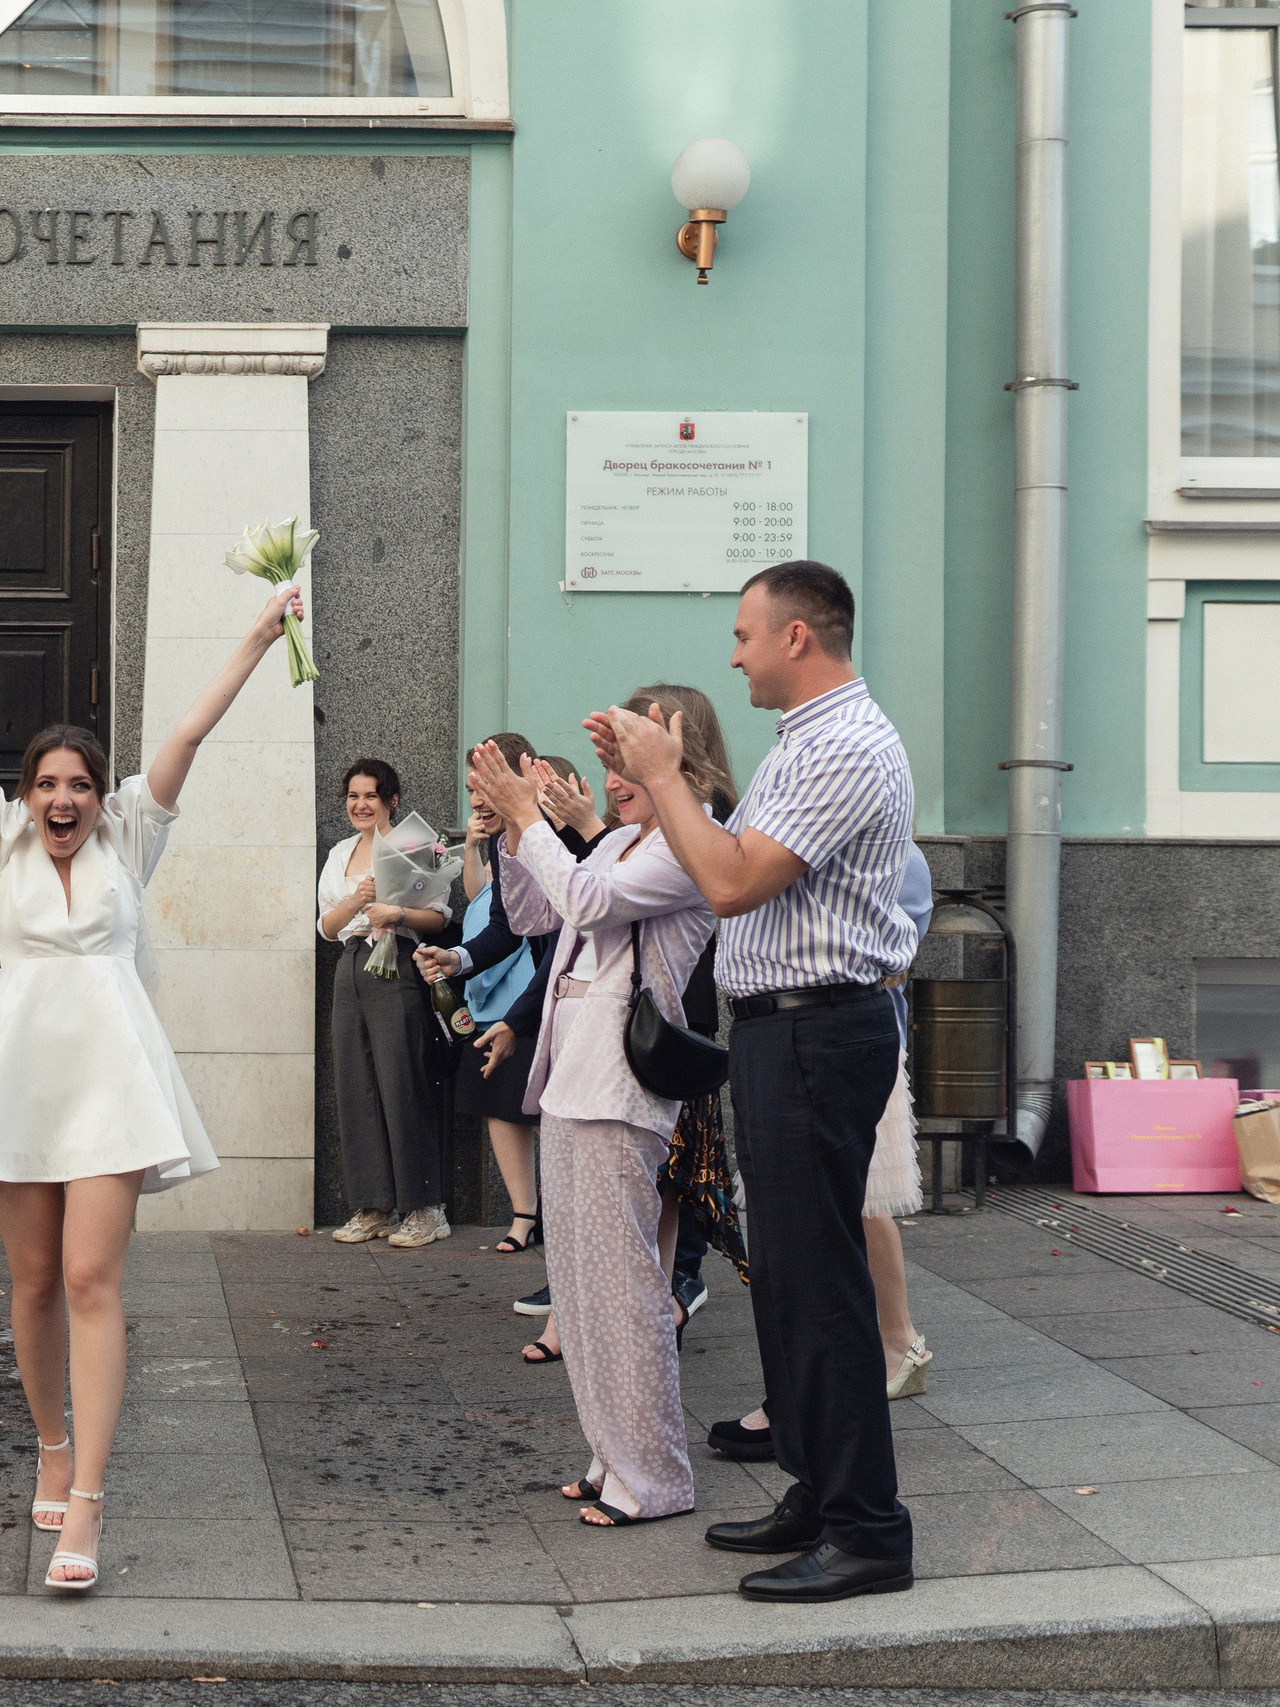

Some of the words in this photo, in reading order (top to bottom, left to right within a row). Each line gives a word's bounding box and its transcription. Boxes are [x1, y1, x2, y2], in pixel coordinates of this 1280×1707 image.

[603, 459, 647, 472] Дворец
[650, 459, 745, 472] бракосочетания
[767, 460, 772, 470] 1
[646, 486, 685, 496] РЕЖИМ
[687, 486, 728, 496] РАБОТЫ
[733, 501, 756, 511] 9:00
[766, 501, 793, 511] 18:00
[733, 517, 756, 526] 9:00
[764, 517, 793, 526] 20:00
[733, 532, 756, 542] 9:00
[764, 532, 793, 542] 23:59
[726, 548, 756, 558] 00:00
[765, 548, 793, 558] 19:00
